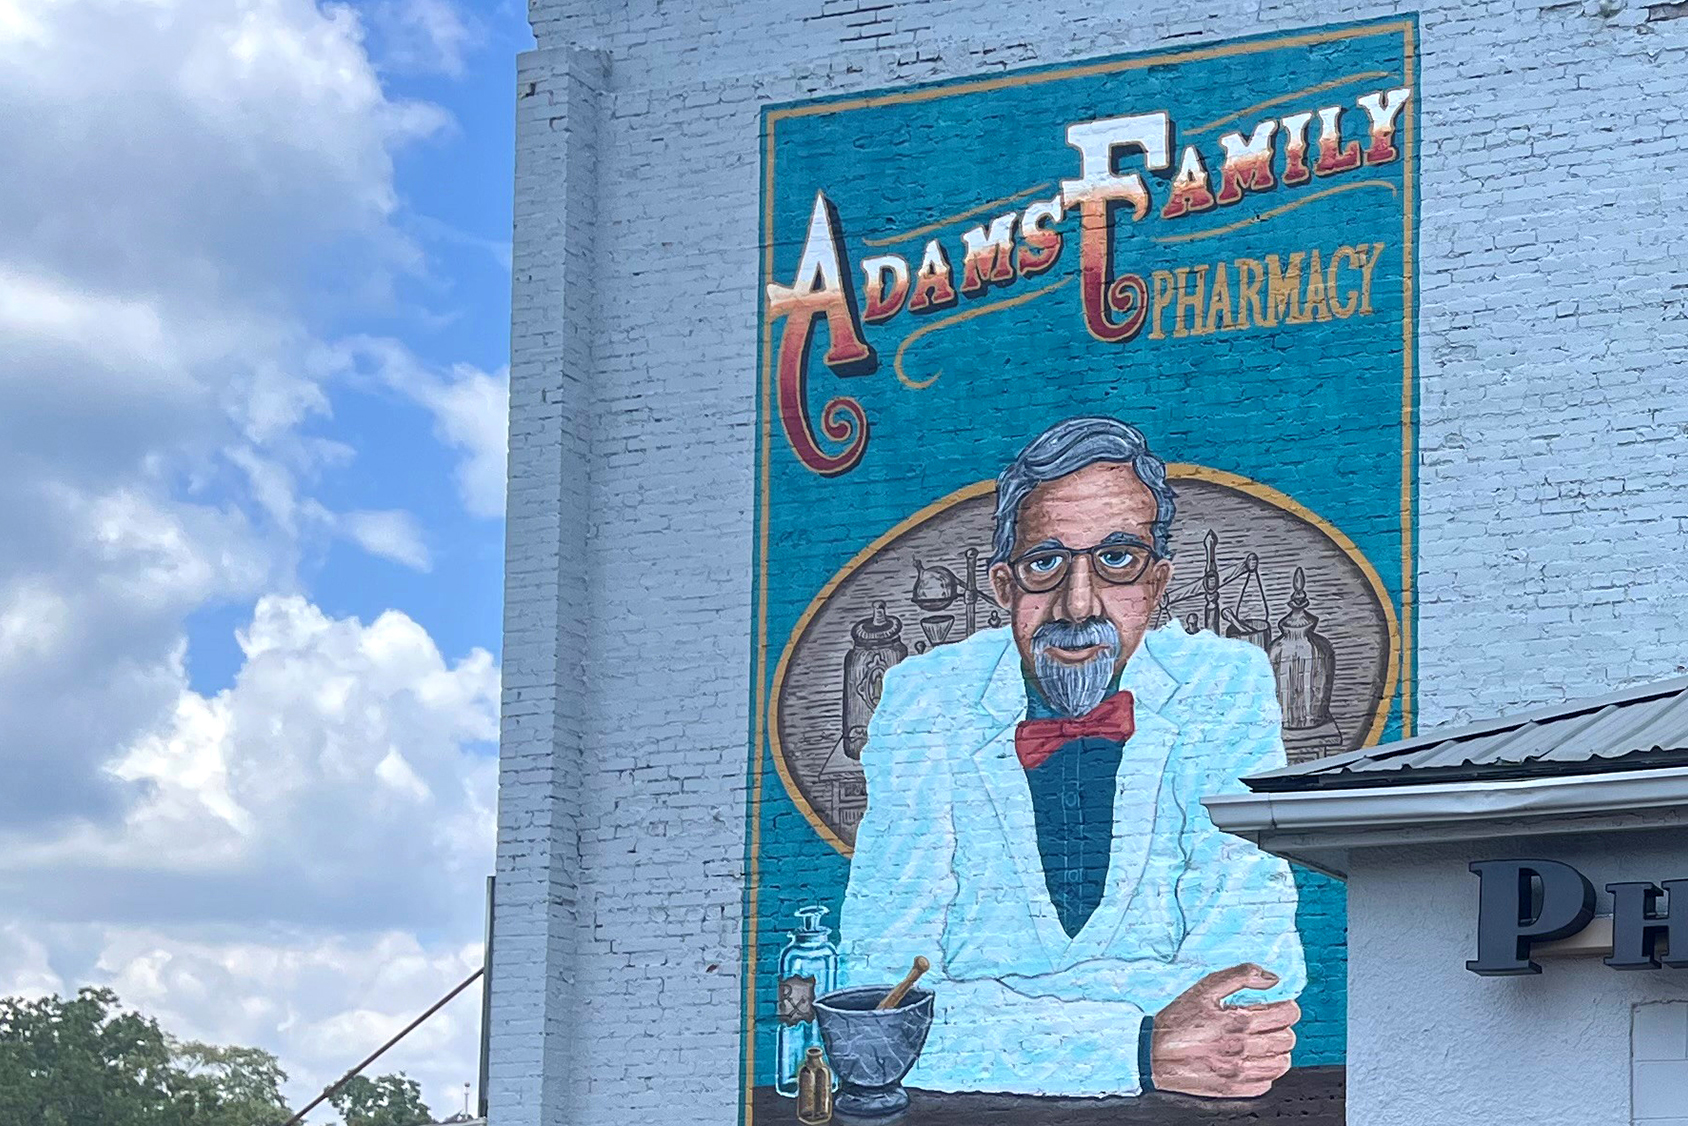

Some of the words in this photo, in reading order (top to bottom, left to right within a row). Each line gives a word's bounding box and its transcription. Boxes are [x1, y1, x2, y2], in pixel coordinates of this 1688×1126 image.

[766, 190, 1065, 475] ADAMS
[1058, 87, 1411, 342] FAMILY
[1148, 241, 1387, 341] PHARMACY
